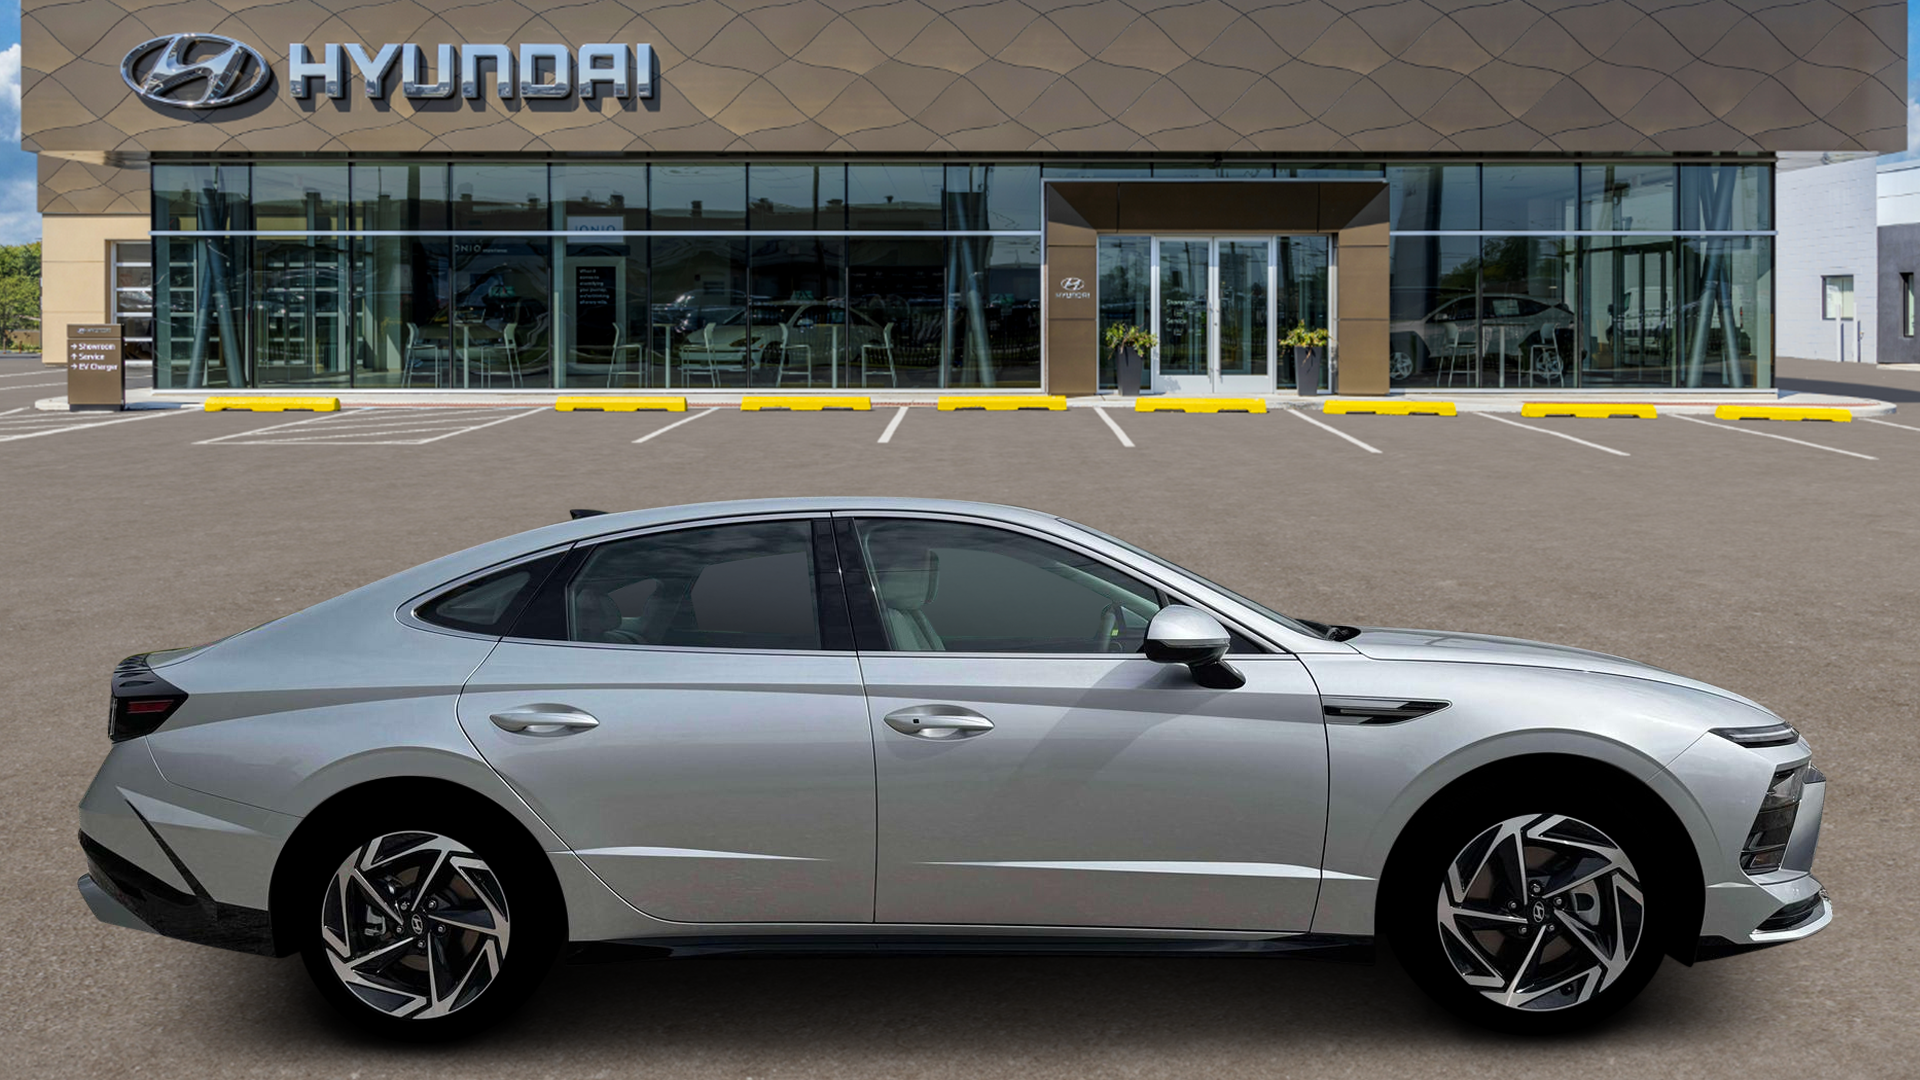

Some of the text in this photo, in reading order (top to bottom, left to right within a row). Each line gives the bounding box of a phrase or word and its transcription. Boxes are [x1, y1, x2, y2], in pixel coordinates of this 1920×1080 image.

[289, 43, 653, 99] HYUNDAI
[78, 353, 105, 361] Service
[90, 363, 118, 372] Charger
